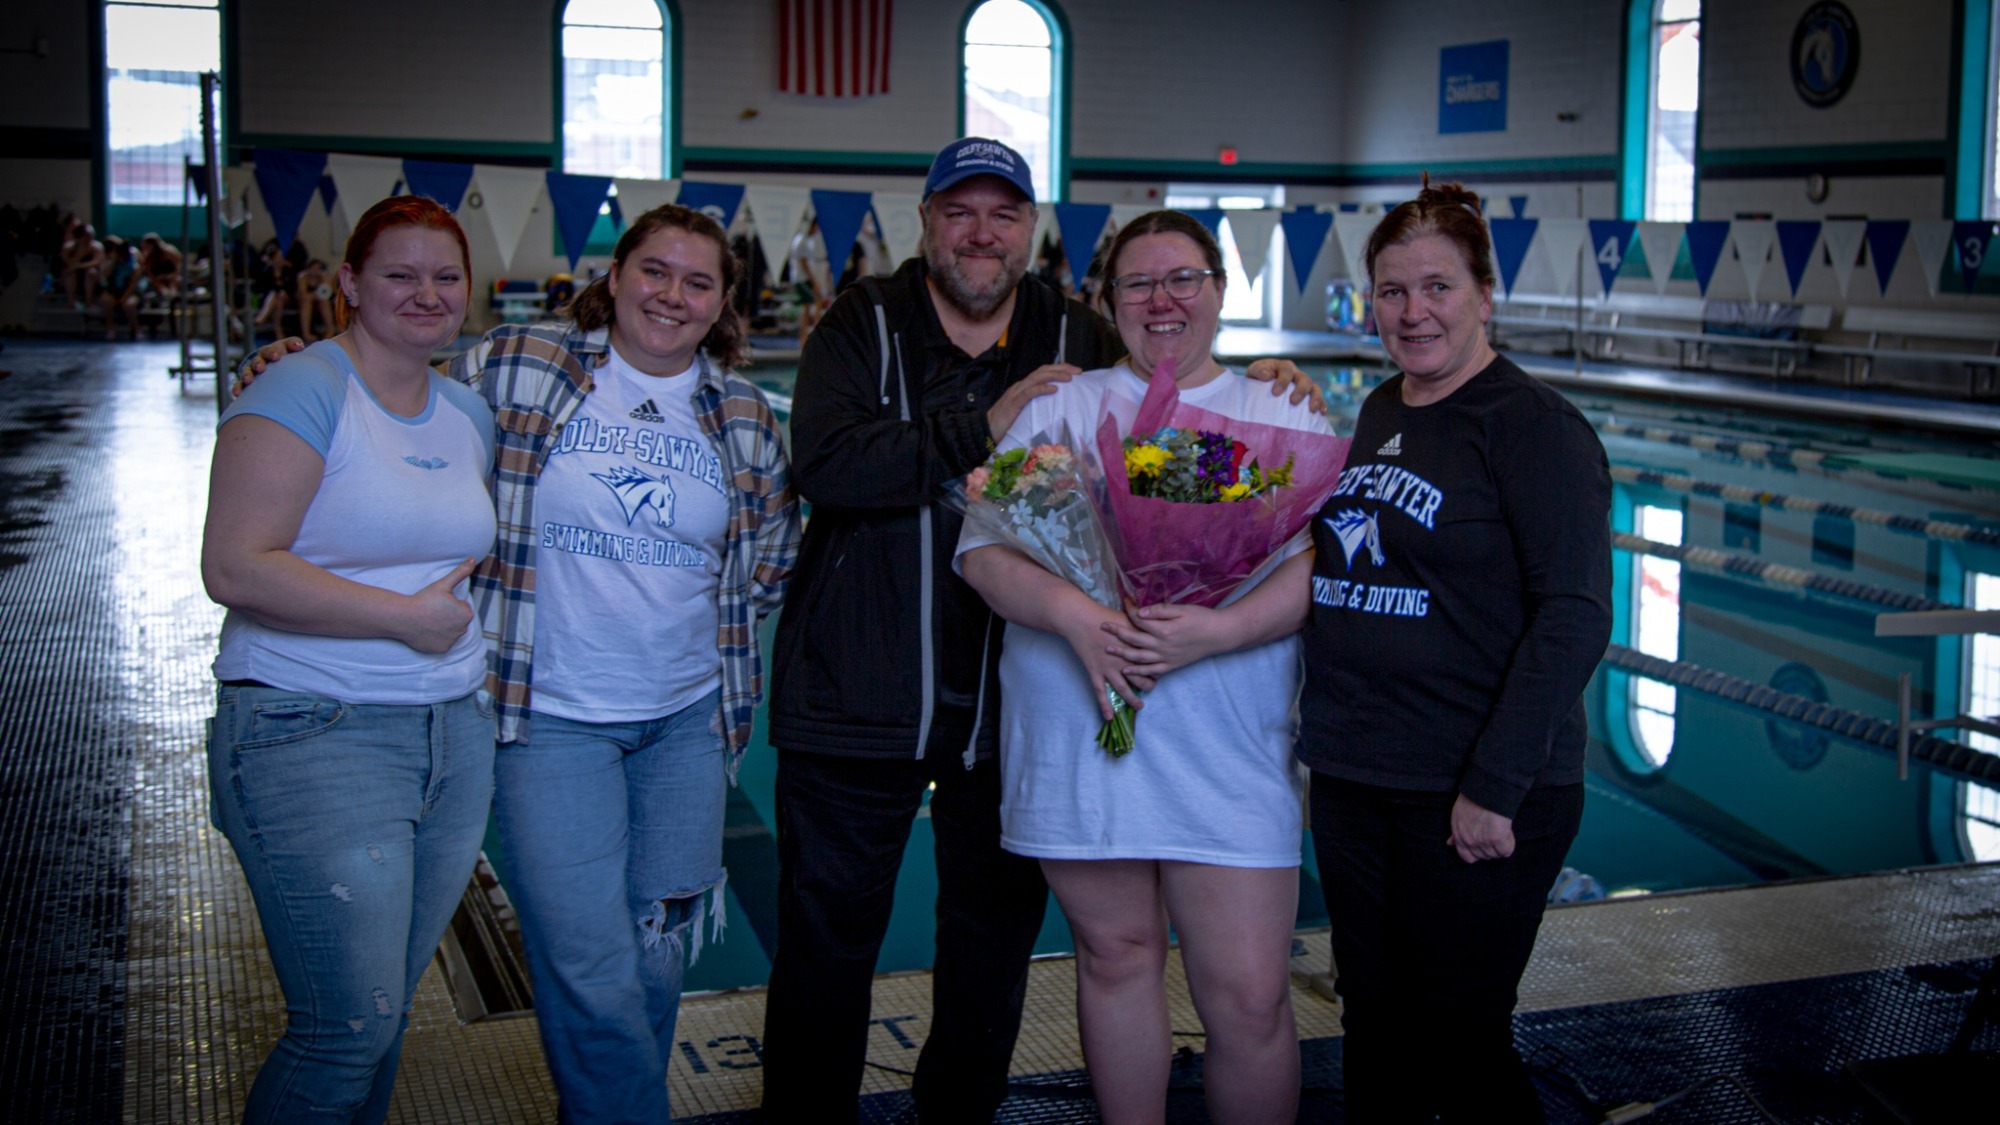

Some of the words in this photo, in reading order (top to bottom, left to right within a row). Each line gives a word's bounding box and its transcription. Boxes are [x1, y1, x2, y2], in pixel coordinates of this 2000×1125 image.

[1598, 236, 1622, 270] 4
[1963, 235, 1983, 269] 3
[629, 411, 665, 423] adidas
[550, 417, 727, 498] OLBY-SAWYE
[1331, 463, 1445, 532] BY-SAWYER
[543, 522, 634, 563] SWIMMING
[636, 538, 649, 565] &
[1347, 582, 1365, 610] &
[1362, 584, 1432, 618] DIVING
[868, 1014, 917, 1049] T
